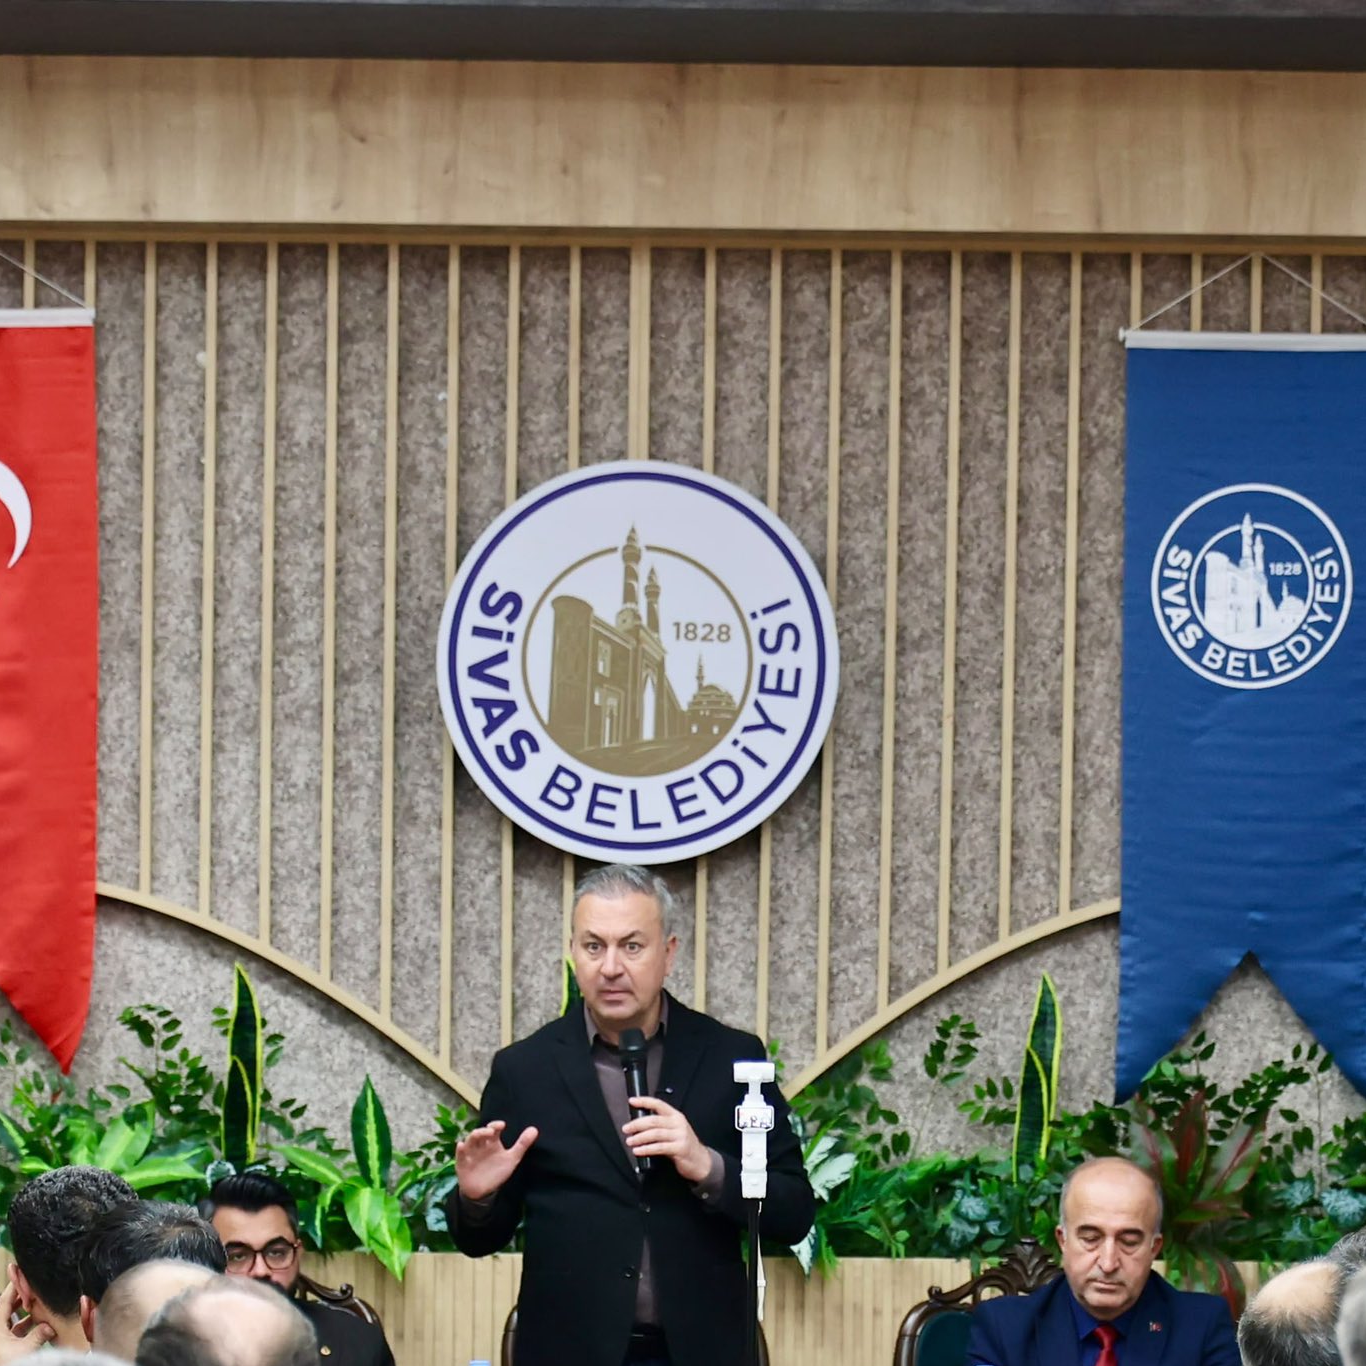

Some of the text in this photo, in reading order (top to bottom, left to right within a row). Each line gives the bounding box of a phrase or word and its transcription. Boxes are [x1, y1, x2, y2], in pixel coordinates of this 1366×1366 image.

[1268, 562, 1303, 576] 1828
[672, 621, 731, 643] 1828
[1161, 545, 1341, 679] SİVAS BELEDİYESİ
[467, 581, 802, 831] SİVAS BELEDİYESİ
